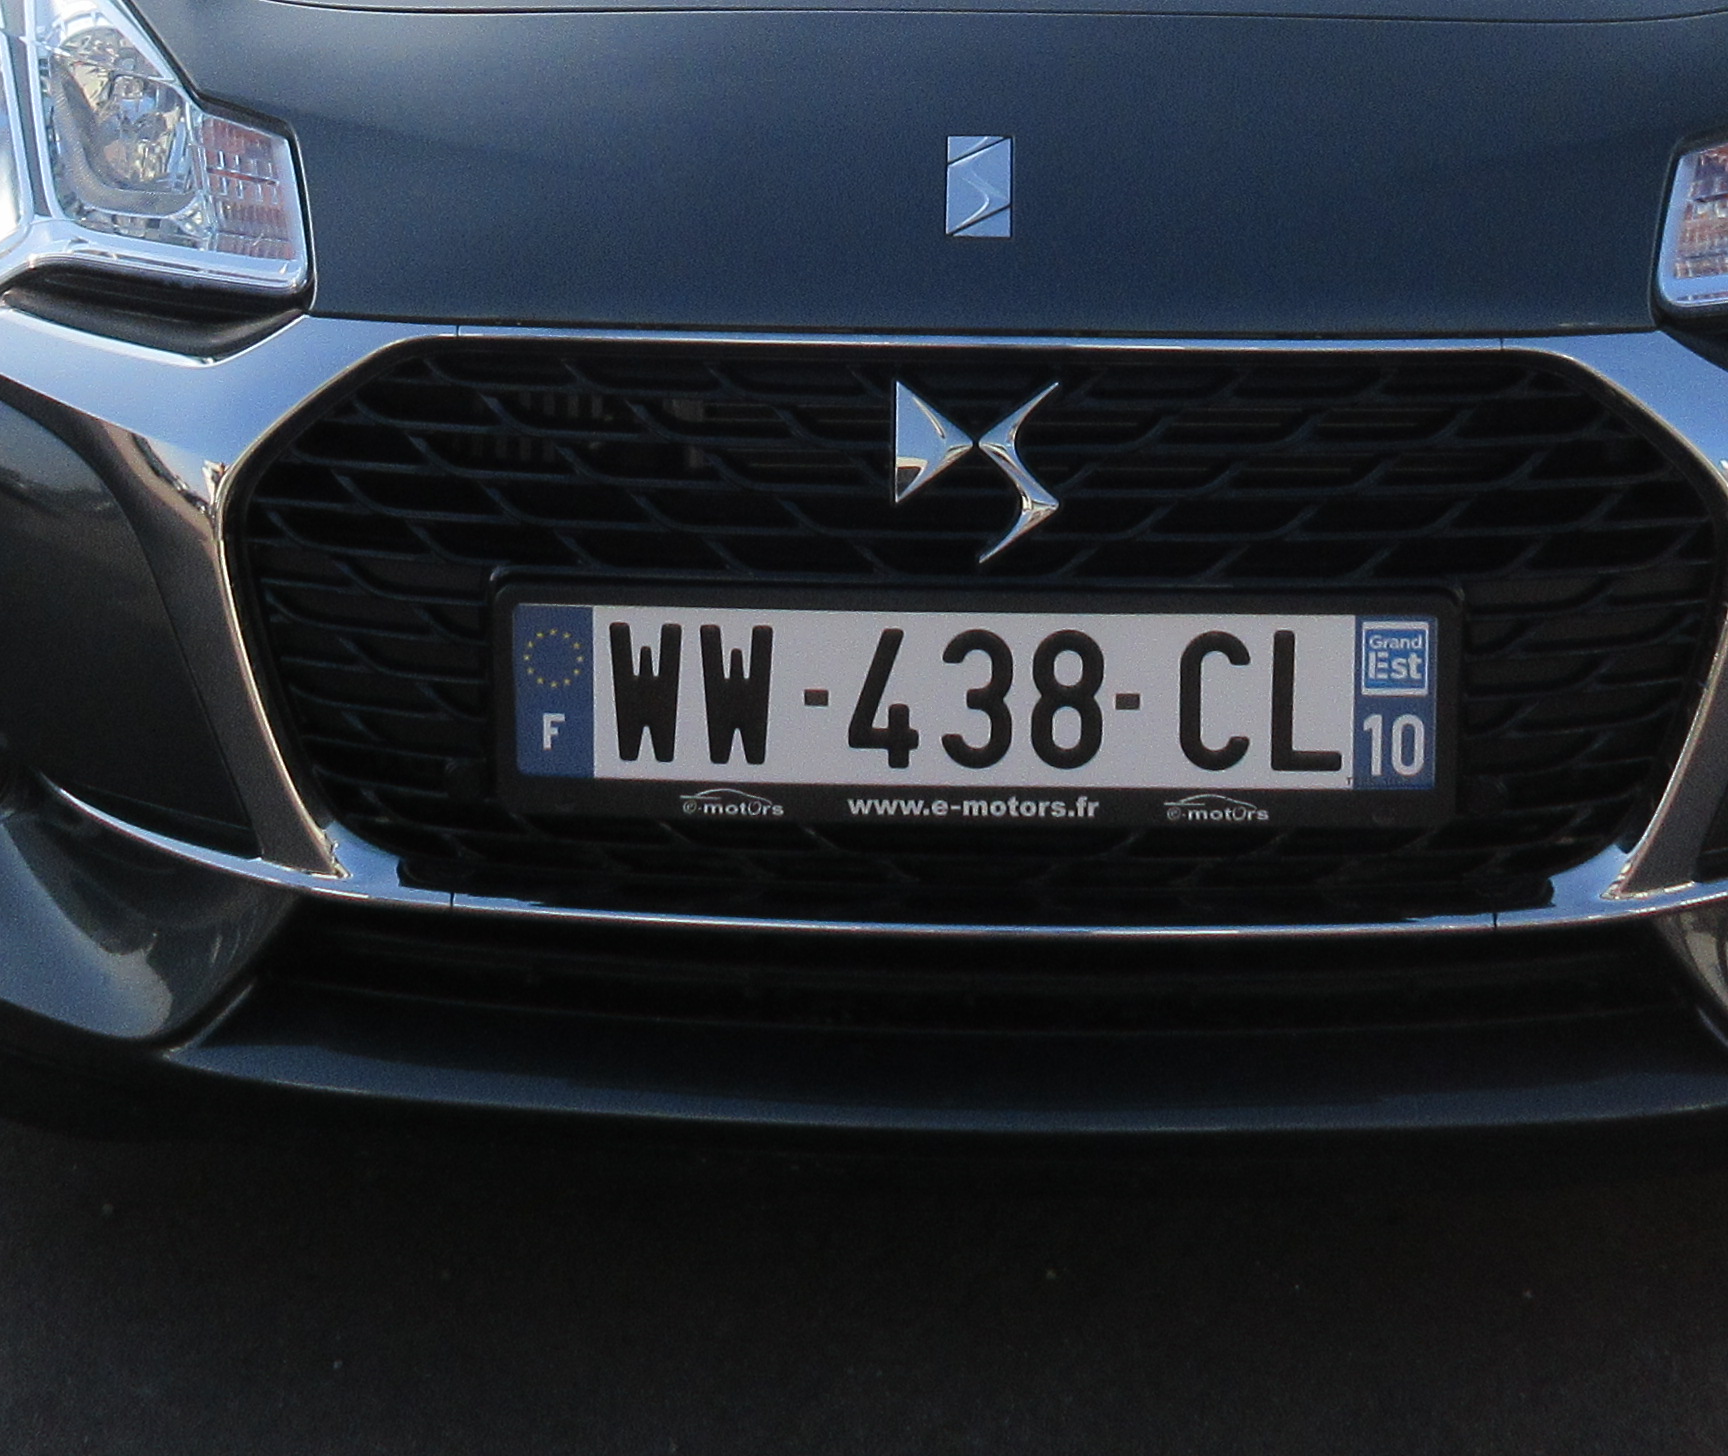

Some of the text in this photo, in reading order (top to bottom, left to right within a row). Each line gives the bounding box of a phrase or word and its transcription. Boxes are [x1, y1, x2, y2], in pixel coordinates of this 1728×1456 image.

[1368, 634, 1422, 650] Grand
[1368, 652, 1423, 680] Est
[543, 713, 565, 751] F
[1363, 714, 1425, 776] 10
[847, 796, 1100, 818] www.e-motors.fr
